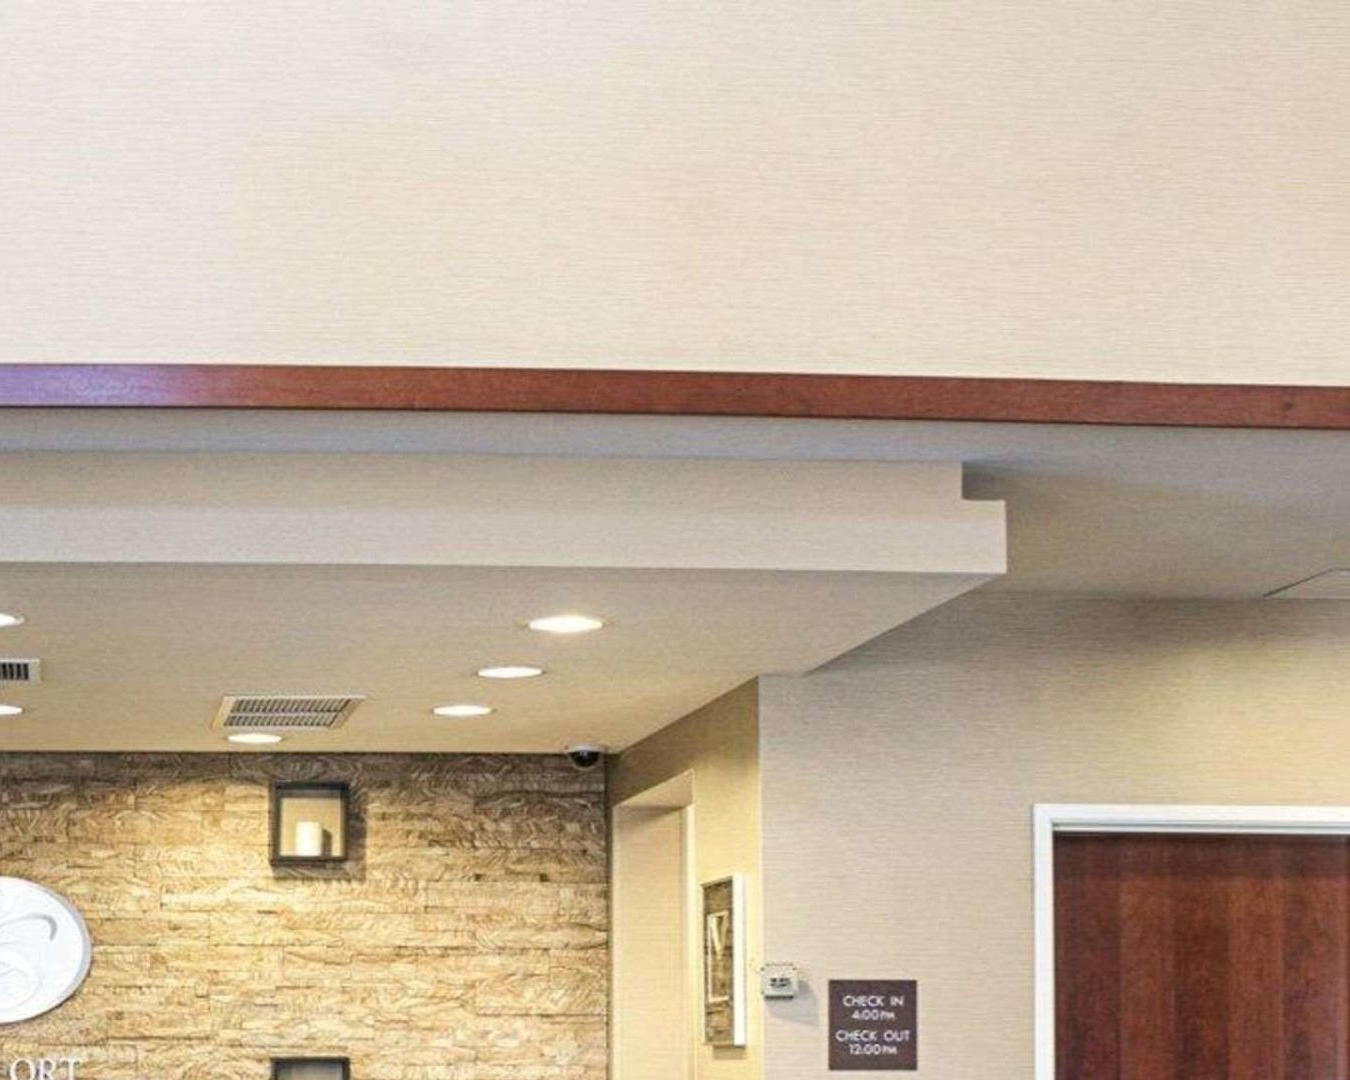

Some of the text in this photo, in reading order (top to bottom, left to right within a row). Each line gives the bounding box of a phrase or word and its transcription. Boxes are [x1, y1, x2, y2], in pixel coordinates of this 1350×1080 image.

[843, 995, 905, 1007] CHECK IN
[835, 1029, 911, 1042] CHECK OUT
